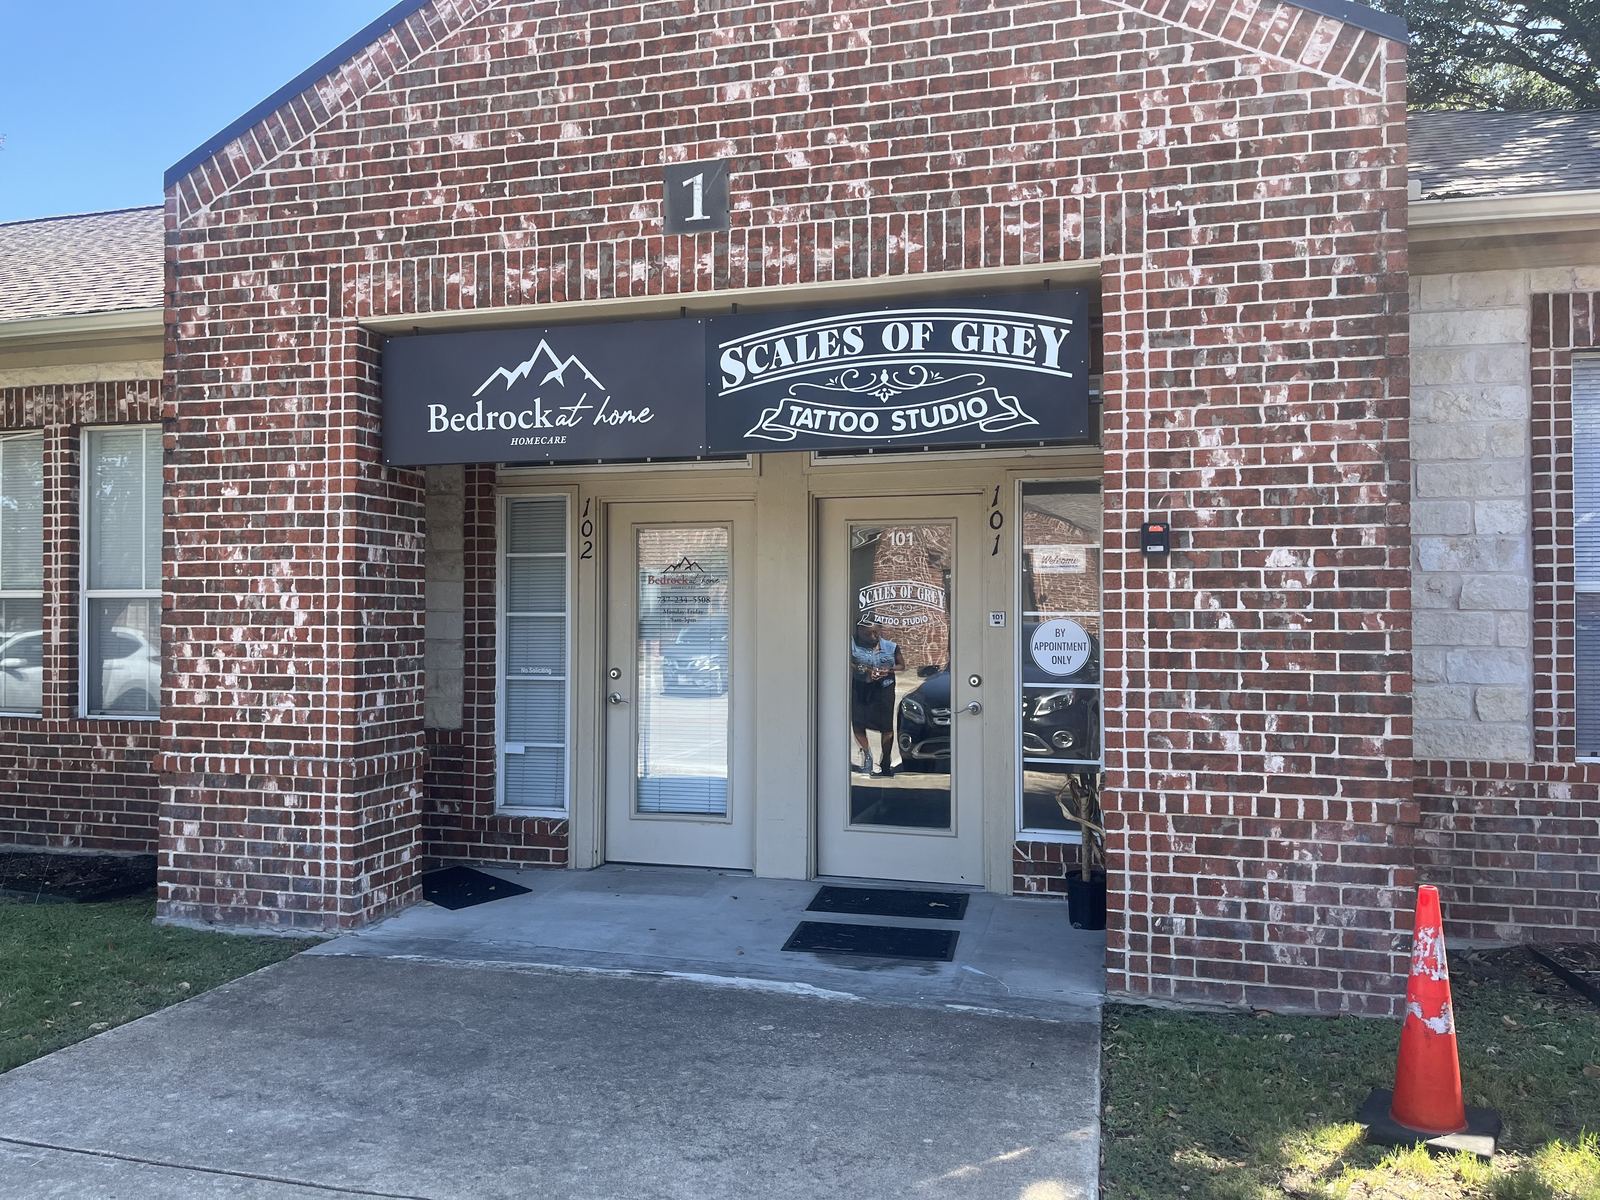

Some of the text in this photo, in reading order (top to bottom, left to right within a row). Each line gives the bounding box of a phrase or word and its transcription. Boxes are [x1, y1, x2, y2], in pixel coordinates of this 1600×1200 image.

[682, 173, 711, 222] 1
[718, 321, 1071, 390] SCALES OF GREY
[427, 392, 655, 433] Bedrock at home
[789, 397, 988, 432] TATTOO STUDIO
[510, 435, 567, 445] HOMECARE
[888, 531, 914, 546] 101
[1041, 554, 1079, 565] Welcome
[647, 575, 689, 585] Bedrock
[859, 585, 945, 610] SCALES OF GREY
[874, 614, 928, 626] TATTOO STUDIO
[1055, 628, 1066, 637] BY
[1034, 641, 1087, 651] APPOINTMENT
[1051, 655, 1072, 665] ONLY
